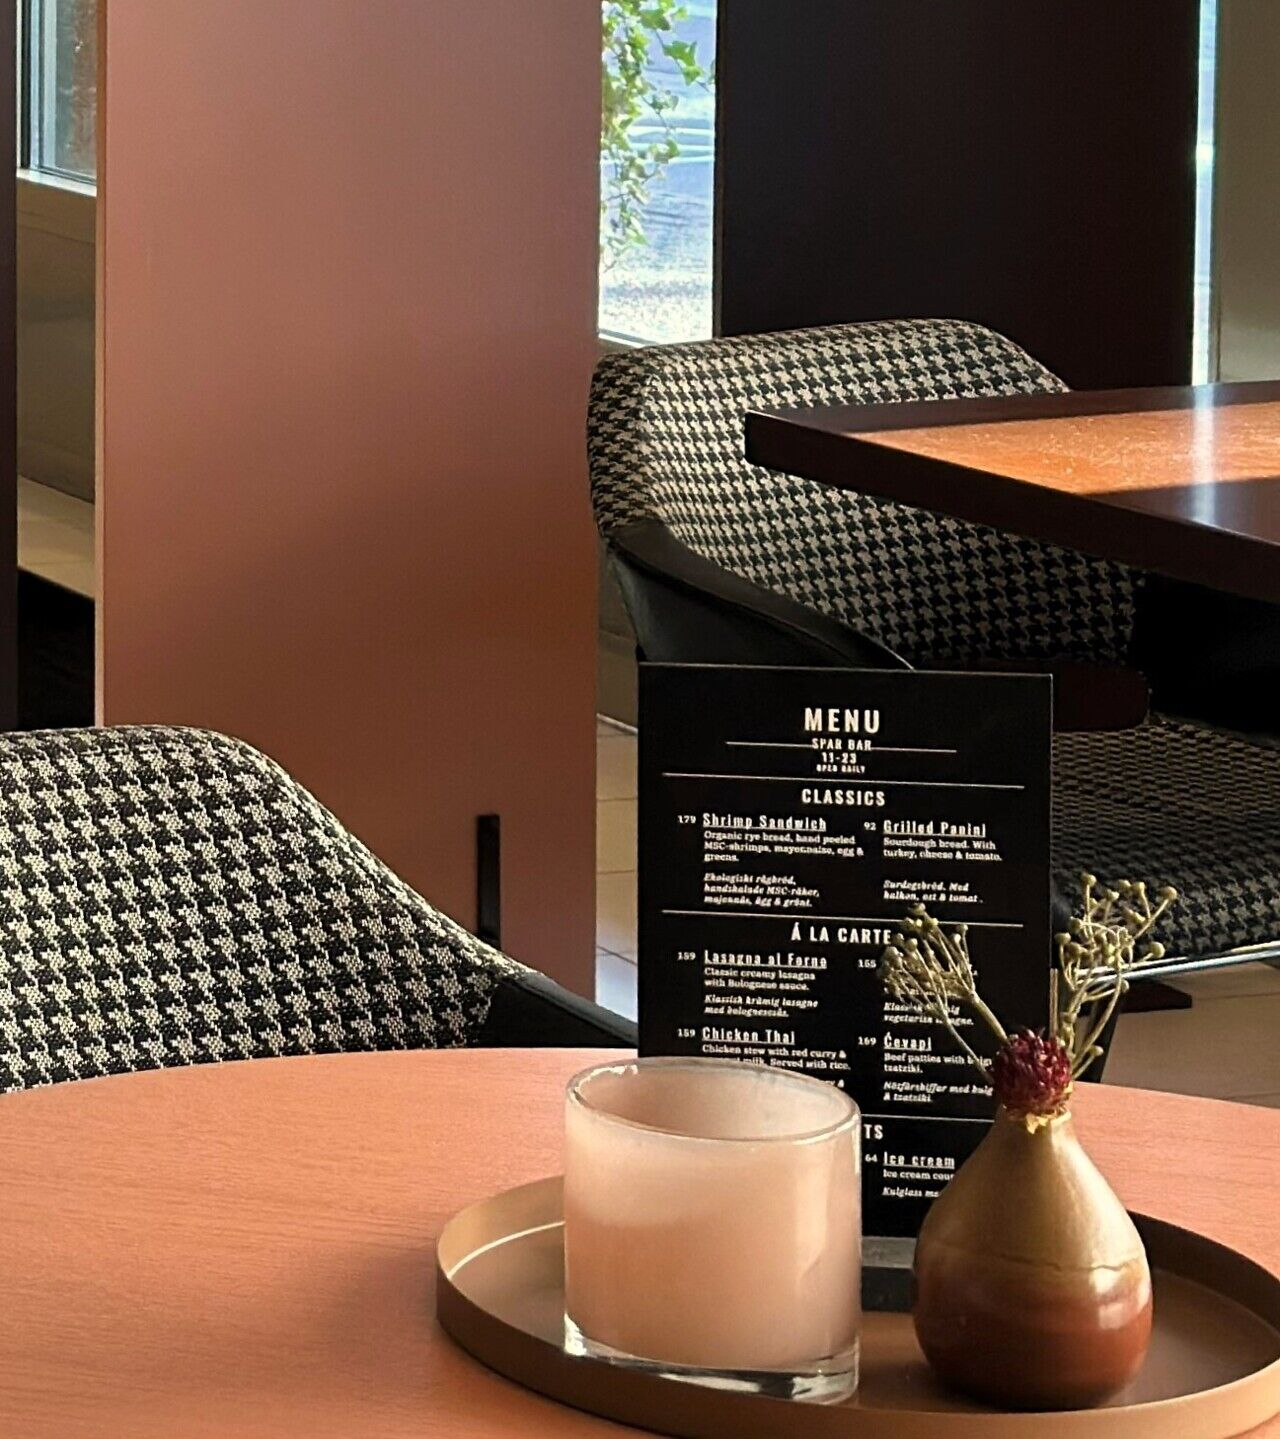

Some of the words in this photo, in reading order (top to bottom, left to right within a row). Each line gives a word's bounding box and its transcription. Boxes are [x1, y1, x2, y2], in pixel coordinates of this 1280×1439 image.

[803, 707, 881, 734] MENU
[811, 738, 843, 750] SPAR
[848, 739, 872, 752] BAR
[821, 751, 857, 764] 11-23
[801, 788, 887, 807] CLASSICS
[703, 813, 753, 830] Shrimp
[759, 815, 827, 832] Sandwich
[883, 819, 934, 835] Grilled
[940, 821, 986, 838] Panini
[809, 926, 830, 942] LA
[837, 927, 891, 945] CARTE
[704, 949, 761, 966] Lasagna
[768, 952, 781, 966] al
[702, 1026, 759, 1043] Chicken
[765, 1028, 795, 1045] Thai
[702, 1044, 741, 1054] Chicken
[883, 1151, 905, 1167] Ice
[911, 1155, 956, 1170] cream
